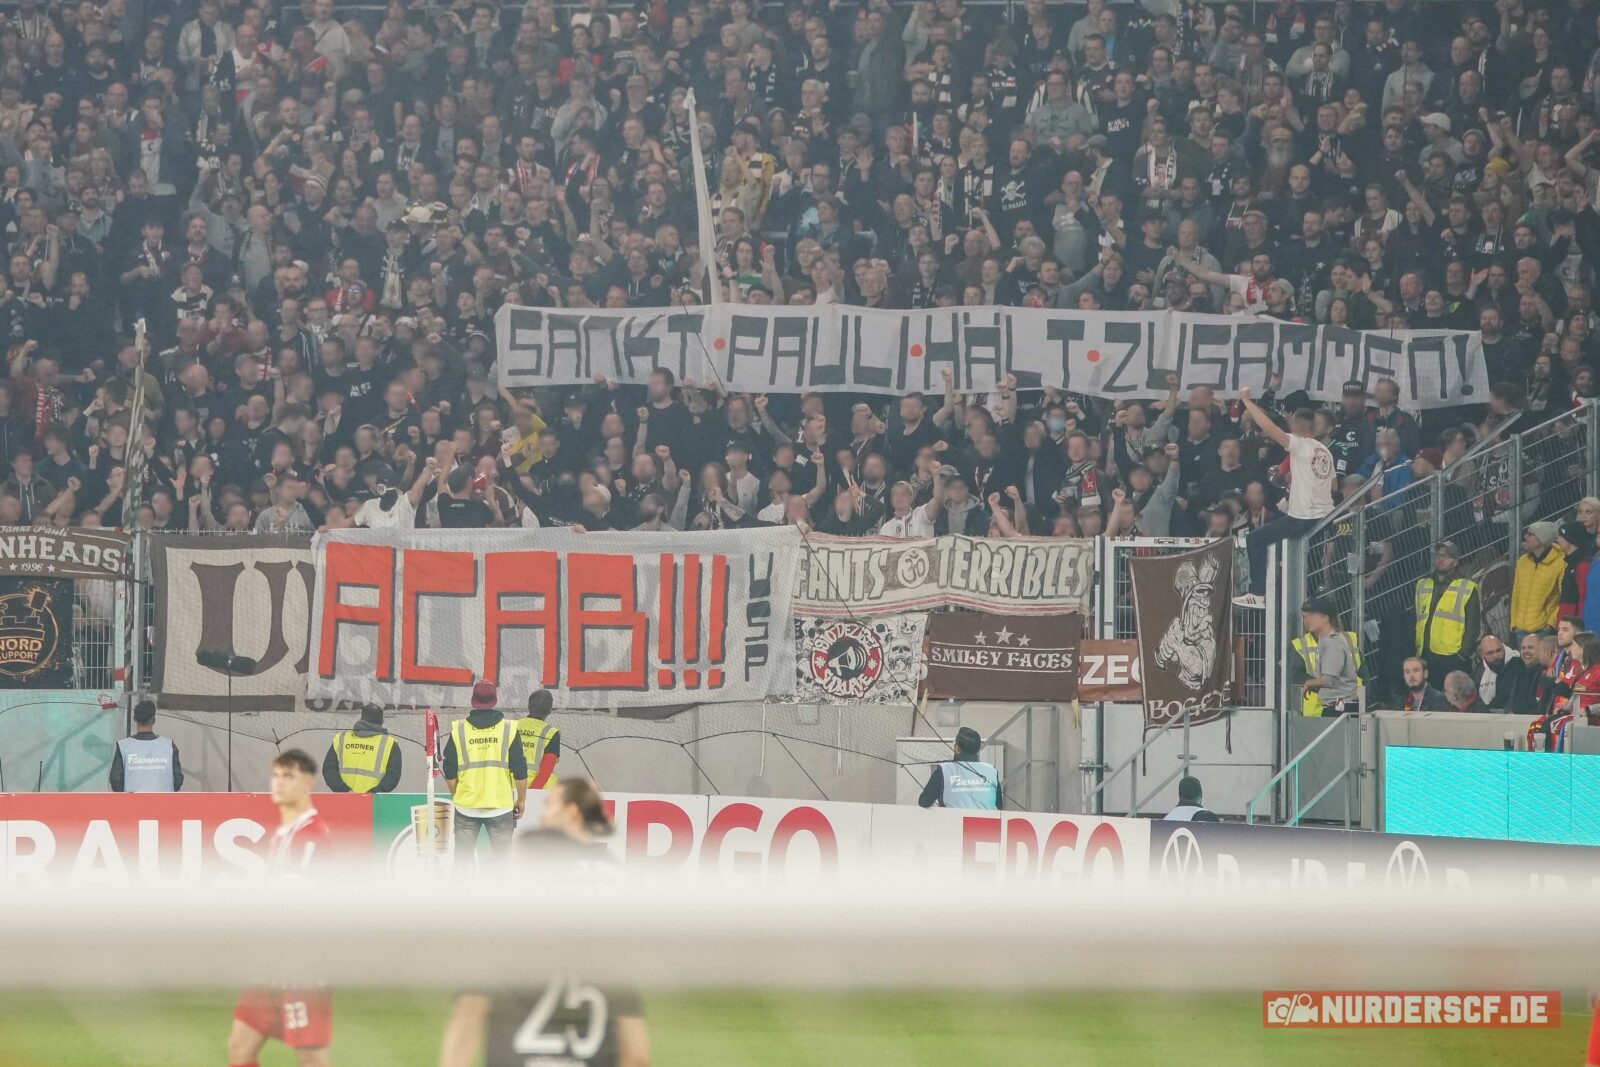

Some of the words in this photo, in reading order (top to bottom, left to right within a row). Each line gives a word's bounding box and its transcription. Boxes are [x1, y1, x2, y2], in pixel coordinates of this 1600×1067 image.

[508, 309, 705, 380] SANKT
[726, 314, 909, 390] PAULI
[1101, 321, 1476, 400] ZUSAMMEN!
[935, 533, 1089, 599] TERRIBLES
[318, 541, 728, 690] ACAB!!!
[931, 647, 1003, 666] SMILEY
[1006, 652, 1073, 669] FACES
[345, 743, 375, 752] ORDNER
[469, 737, 499, 745] ORDNER
[284, 1001, 309, 1029] 33
[512, 973, 608, 1060] 25
